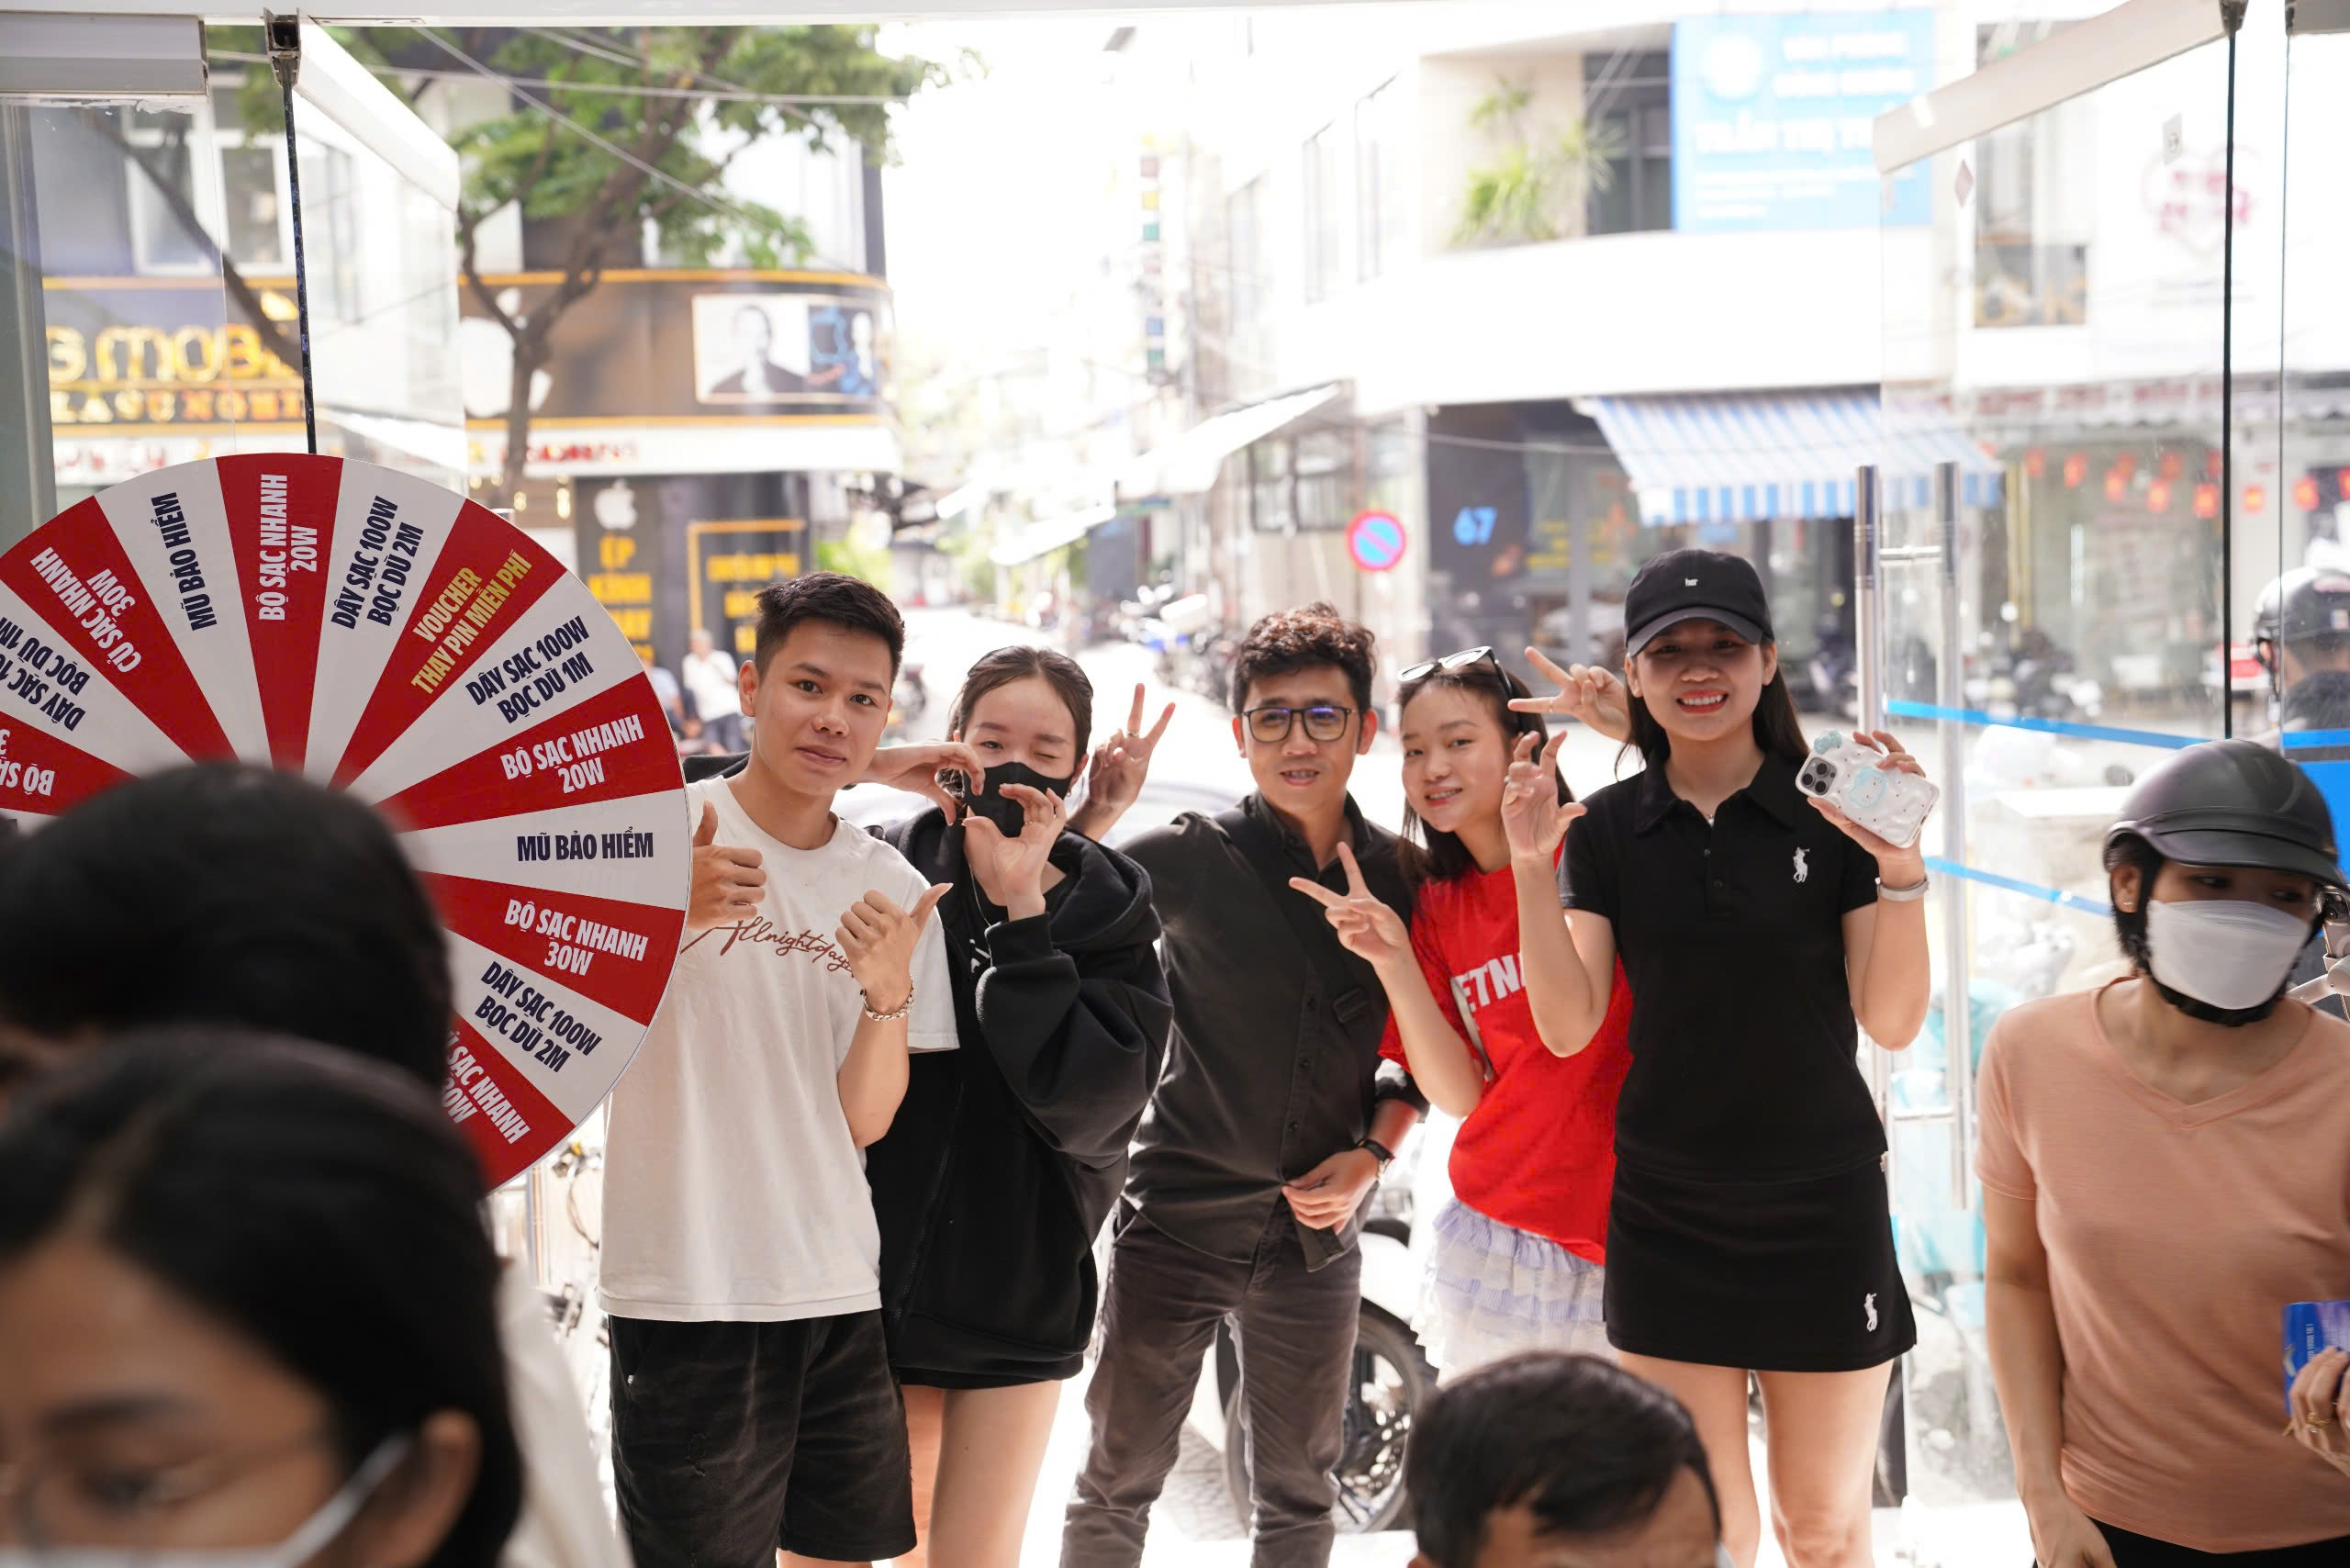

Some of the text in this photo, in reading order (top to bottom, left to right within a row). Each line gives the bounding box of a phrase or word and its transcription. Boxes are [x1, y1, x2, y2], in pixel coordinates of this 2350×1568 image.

[255, 475, 289, 620] BỘ SẠC NHANH
[290, 525, 317, 571] 20W
[1453, 506, 1497, 545] 67
[86, 568, 136, 617] 30W
[151, 492, 217, 631] MŨ BẢO HIỂM
[331, 496, 397, 630] DÂY SẠC 100W
[367, 583, 401, 626] BỌC
[392, 521, 423, 557] 2M
[0, 617, 24, 649] 1M
[29, 546, 141, 673] CỦ SẠC NHANH
[411, 549, 532, 694] THAY PIN MIỄN PHÍ
[413, 567, 482, 643] VOUCHER
[7, 668, 49, 704] SẠC
[45, 655, 90, 696] BỌC
[465, 666, 507, 705] DÂY
[503, 647, 542, 683] SẠC
[536, 615, 589, 661] 100W
[497, 685, 541, 723] BỌC
[562, 652, 594, 683] 1M
[40, 693, 85, 731] DÂY
[500, 714, 644, 779] BỘ SẠC NHANH
[558, 757, 605, 793] 20W
[23, 764, 55, 796] BỘ
[518, 827, 653, 861] MŨ BẢO HIỂM
[504, 899, 649, 962] BỘ SẠC NHANH
[543, 942, 594, 976] 30W
[481, 961, 602, 1056] DÂY SẠC 100W
[1450, 952, 1527, 1013] ETN
[475, 995, 570, 1072] BỌC DÙ 2M
[469, 1076, 531, 1145] NHANH
